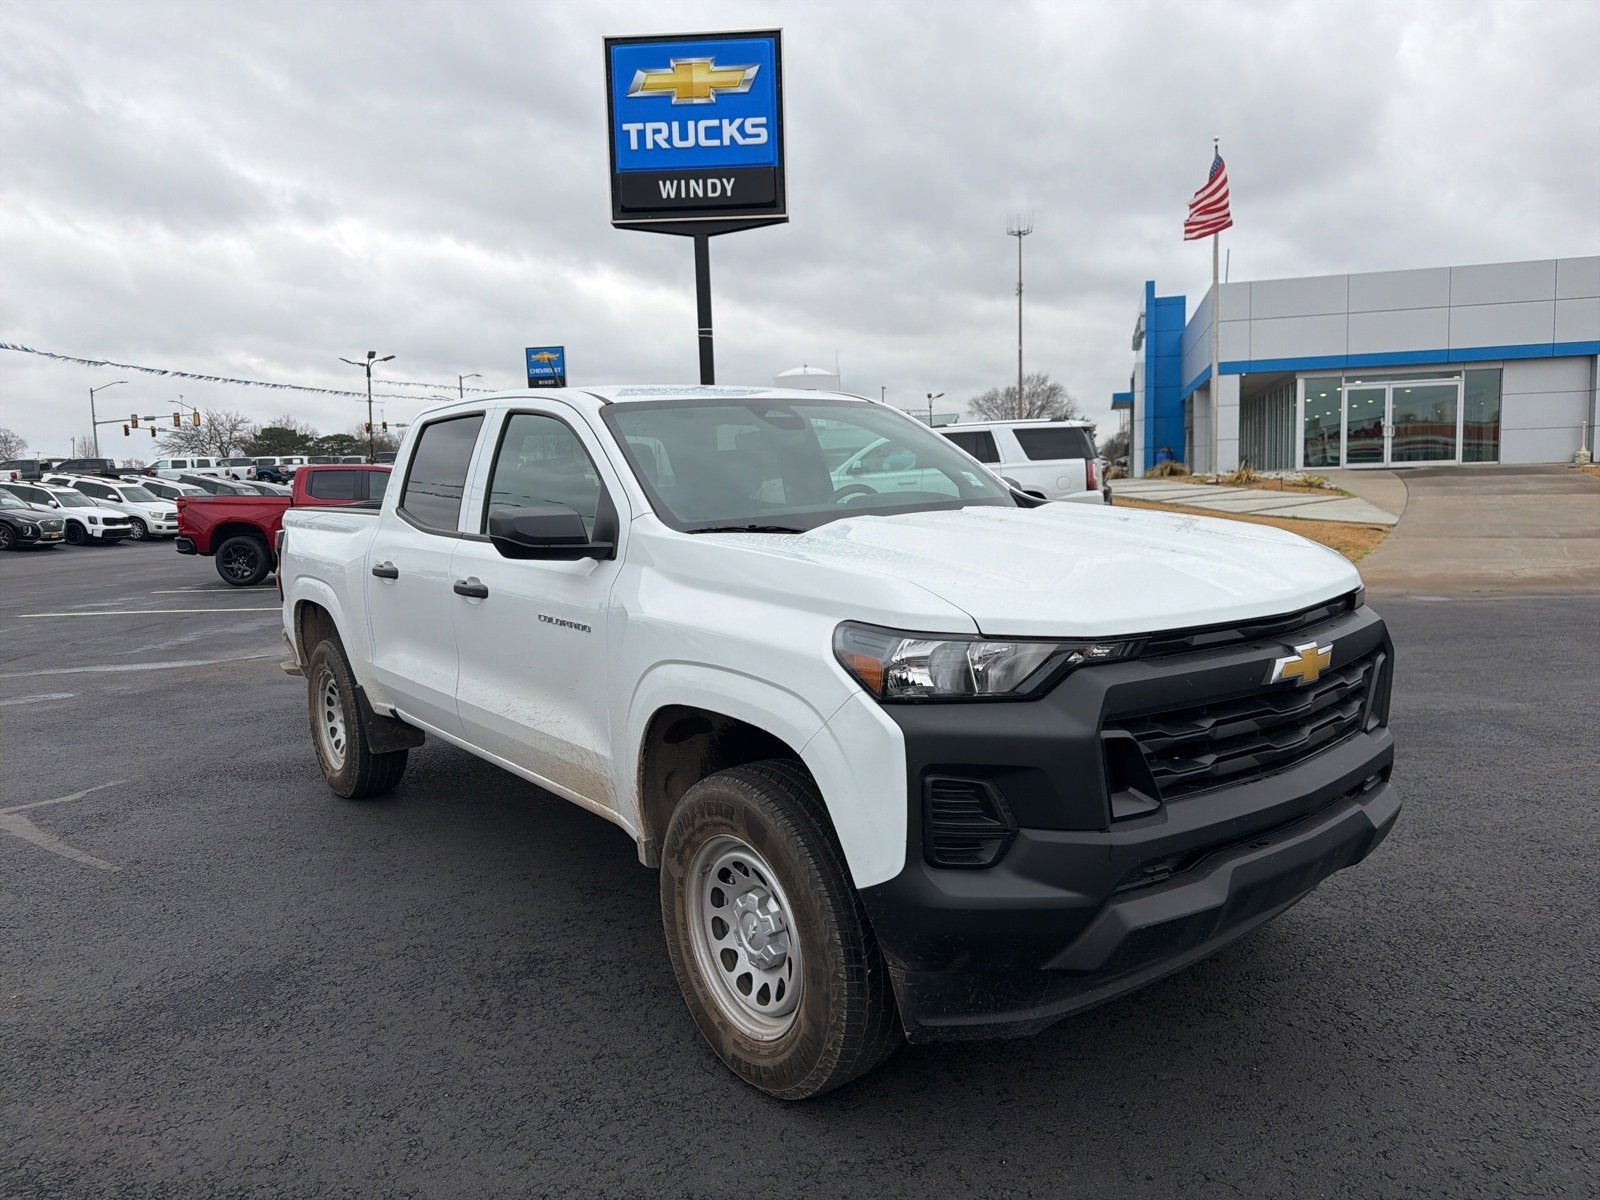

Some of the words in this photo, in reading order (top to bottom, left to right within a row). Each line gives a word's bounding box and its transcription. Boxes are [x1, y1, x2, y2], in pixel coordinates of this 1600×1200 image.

[622, 116, 769, 151] TRUCKS
[658, 177, 736, 199] WINDY
[537, 614, 592, 633] COLORADO
